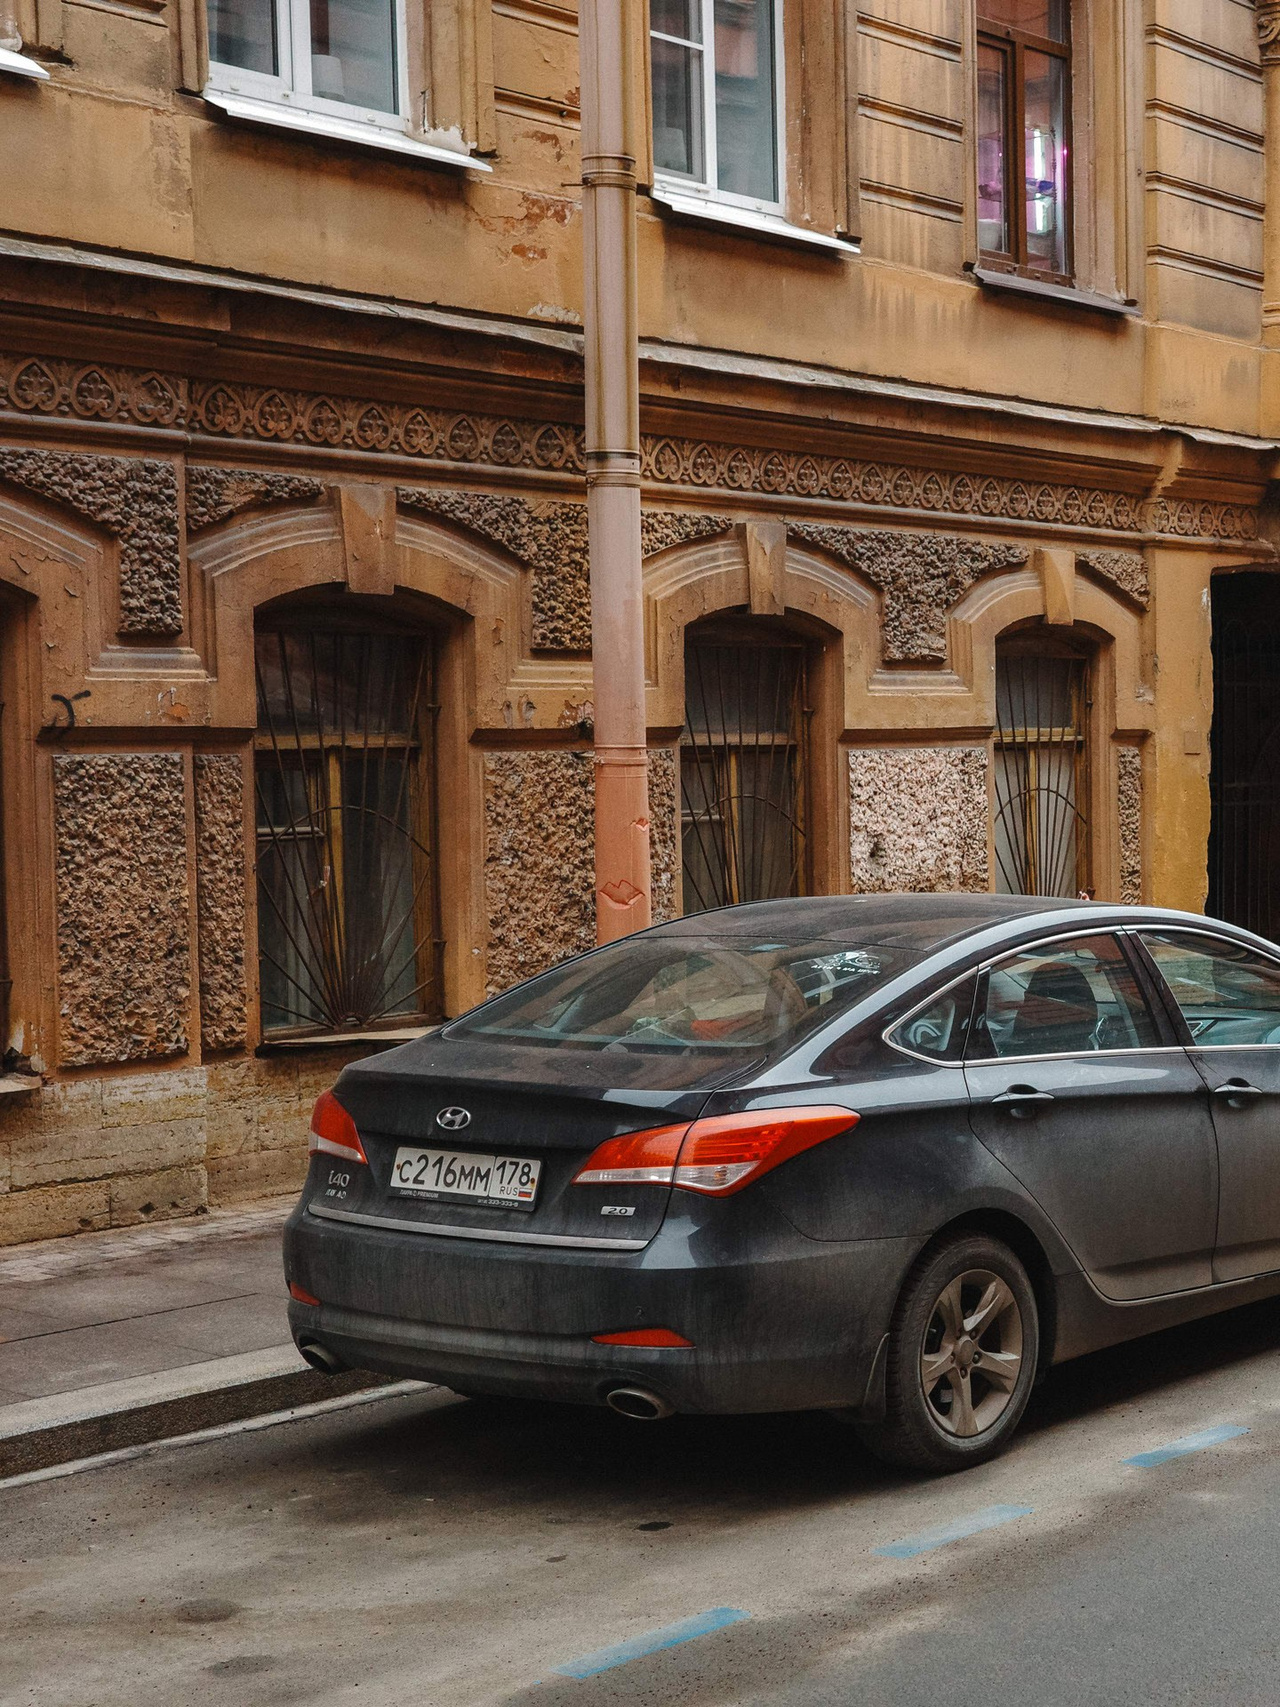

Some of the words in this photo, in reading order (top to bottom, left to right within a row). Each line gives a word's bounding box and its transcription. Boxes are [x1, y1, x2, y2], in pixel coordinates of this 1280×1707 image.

[399, 1153, 492, 1192] С216ММ
[496, 1160, 532, 1187] 178
[499, 1186, 519, 1197] RUS
